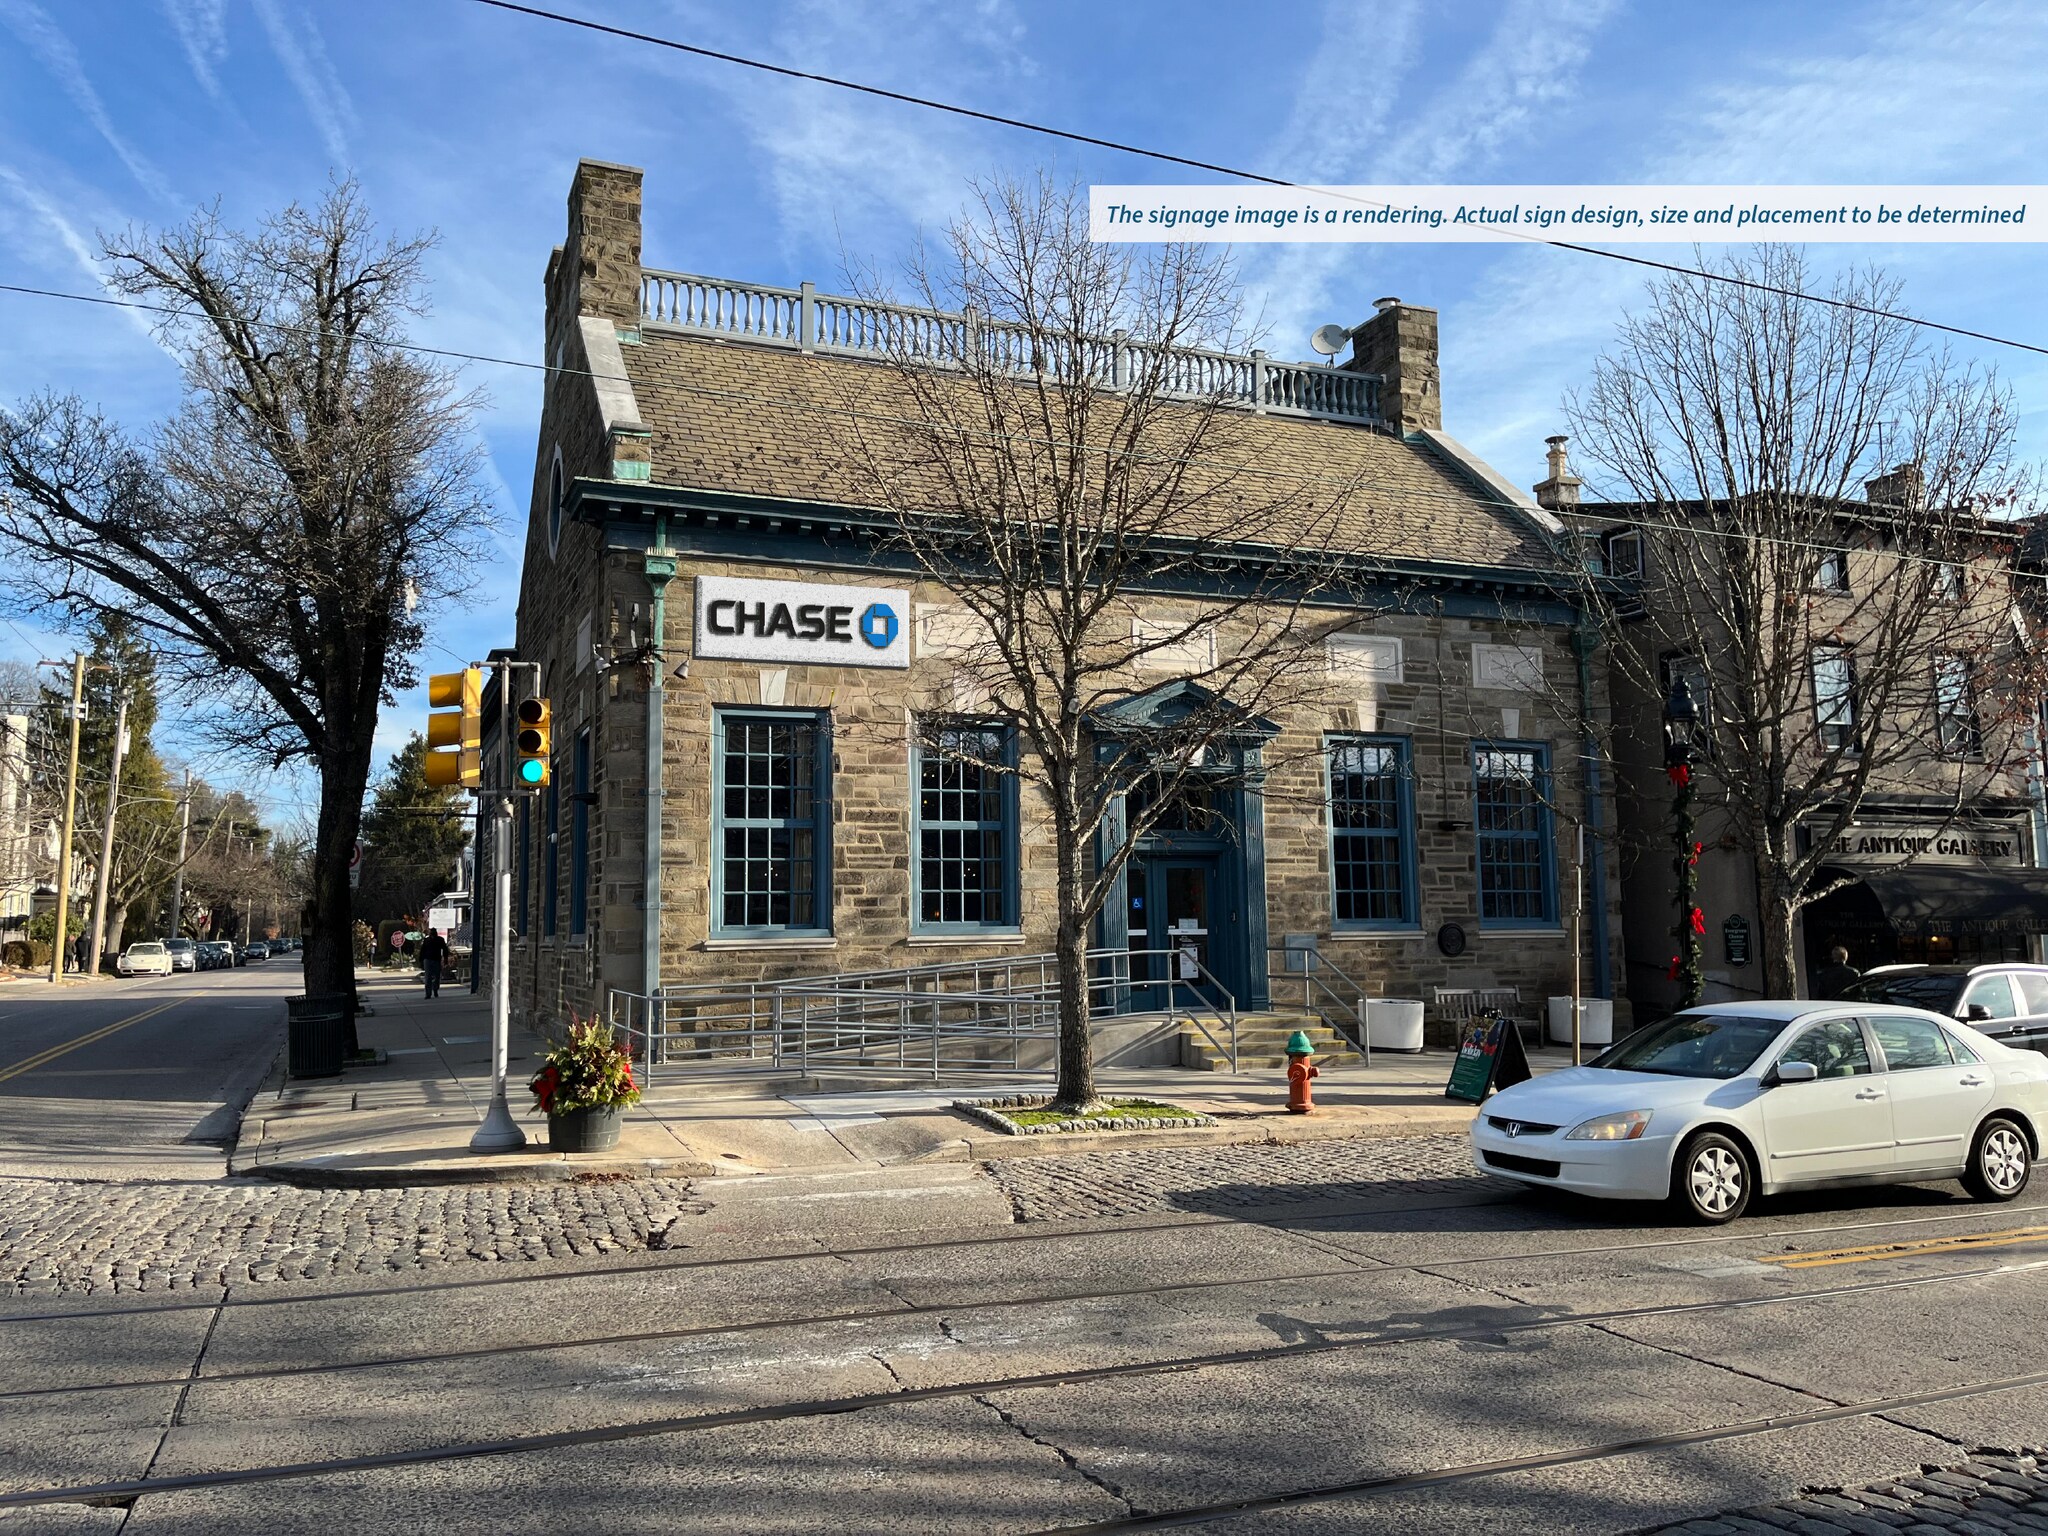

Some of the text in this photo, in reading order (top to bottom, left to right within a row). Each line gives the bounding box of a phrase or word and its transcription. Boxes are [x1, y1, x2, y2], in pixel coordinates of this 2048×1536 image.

[707, 599, 854, 643] CHASE
[1817, 837, 1852, 853] HE
[1858, 836, 1932, 855] ANTIQUE
[1928, 920, 1952, 933] THE
[1961, 919, 2009, 933] ANTIQUE
